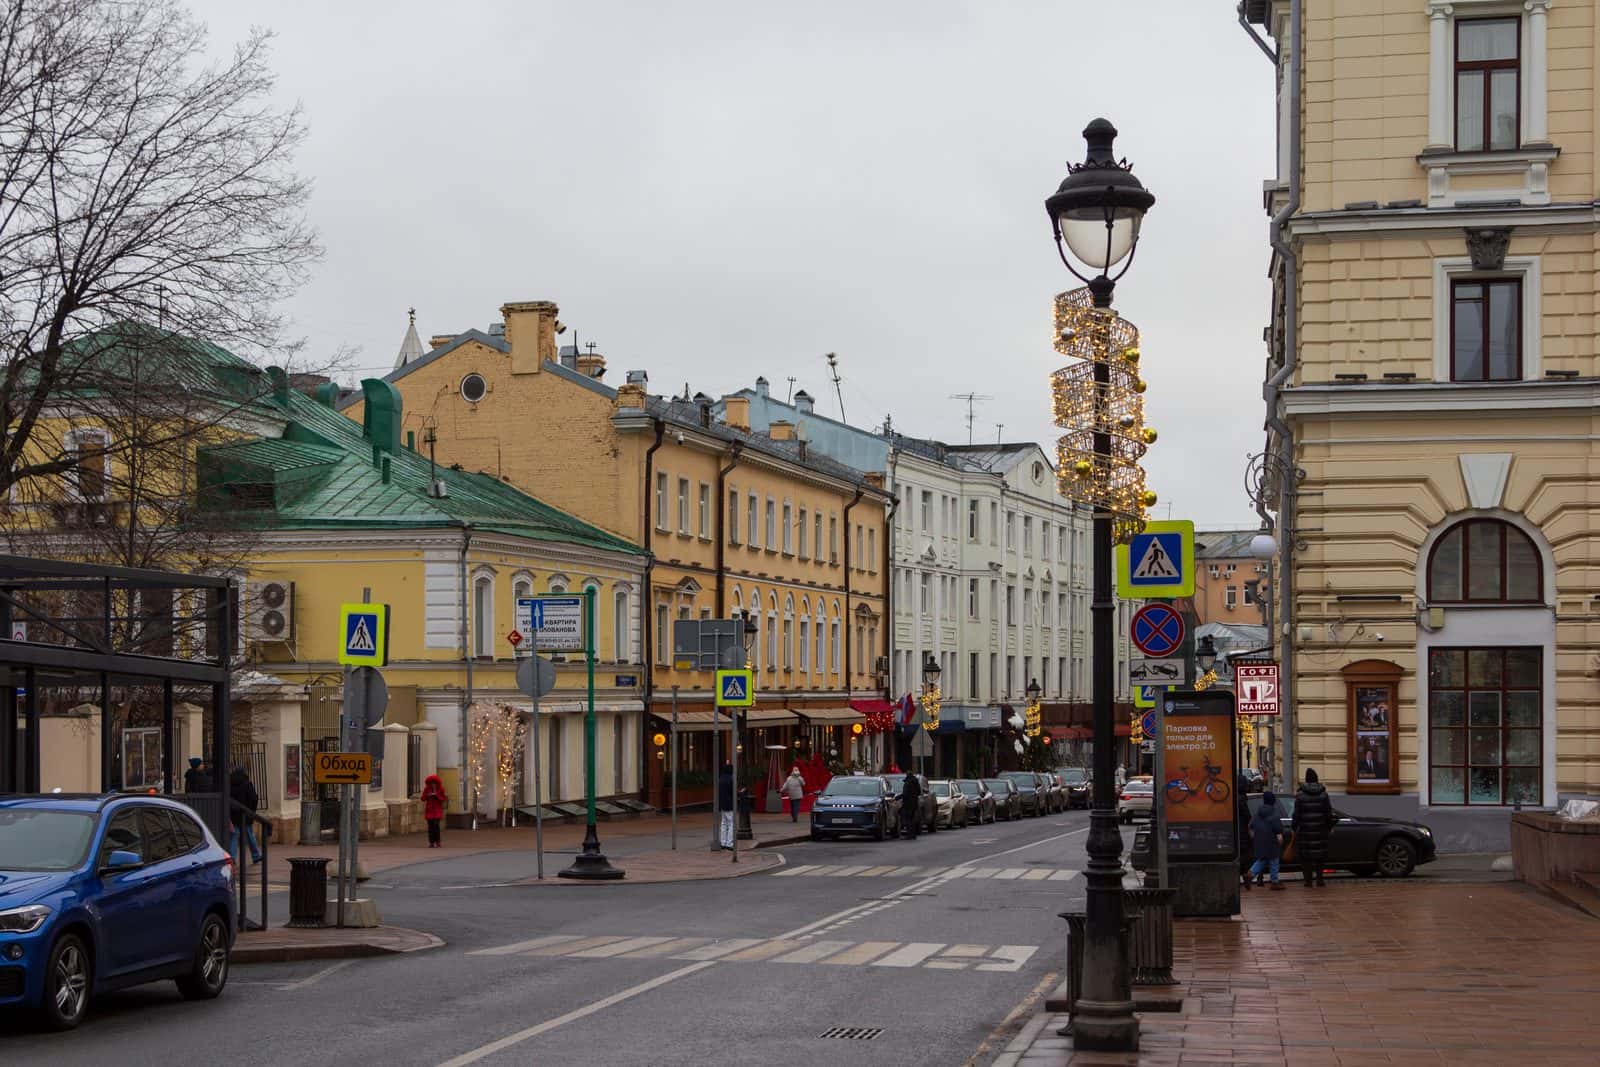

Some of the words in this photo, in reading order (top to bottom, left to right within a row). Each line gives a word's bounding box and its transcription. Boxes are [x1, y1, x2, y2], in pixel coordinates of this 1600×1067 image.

[1240, 668, 1275, 676] КОФЕ
[1240, 703, 1275, 711] МАНИЯ
[1166, 724, 1208, 734] Парковка
[1166, 743, 1201, 751] электро
[1202, 742, 1216, 750] 2.0
[320, 755, 366, 771] Обход
